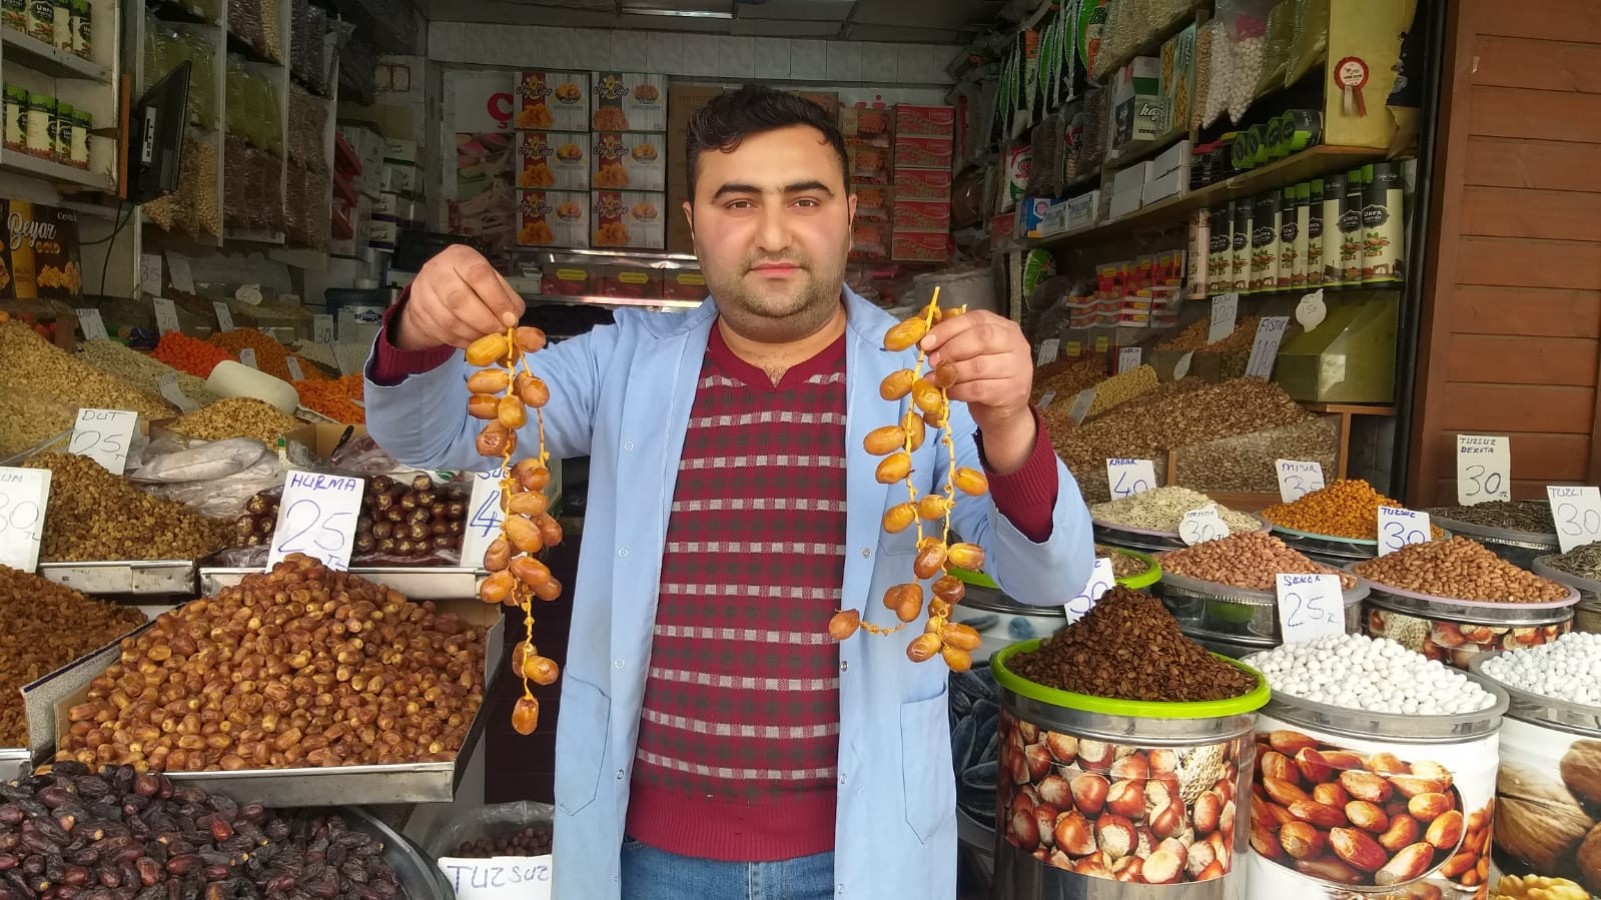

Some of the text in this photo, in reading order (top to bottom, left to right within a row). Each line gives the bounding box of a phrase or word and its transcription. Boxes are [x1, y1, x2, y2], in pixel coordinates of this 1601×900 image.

[8, 212, 57, 250] Beyaz
[82, 410, 128, 422] DUT
[290, 474, 357, 492] HURMA
[1114, 471, 1148, 497] 40
[1465, 464, 1502, 497] 30
[278, 499, 353, 568] 25 TL
[1186, 520, 1216, 543] 30
[1557, 502, 1601, 536] 30
[1383, 521, 1426, 549] 30
[1284, 592, 1325, 628] 25
[446, 864, 550, 895] TUZSUZ
